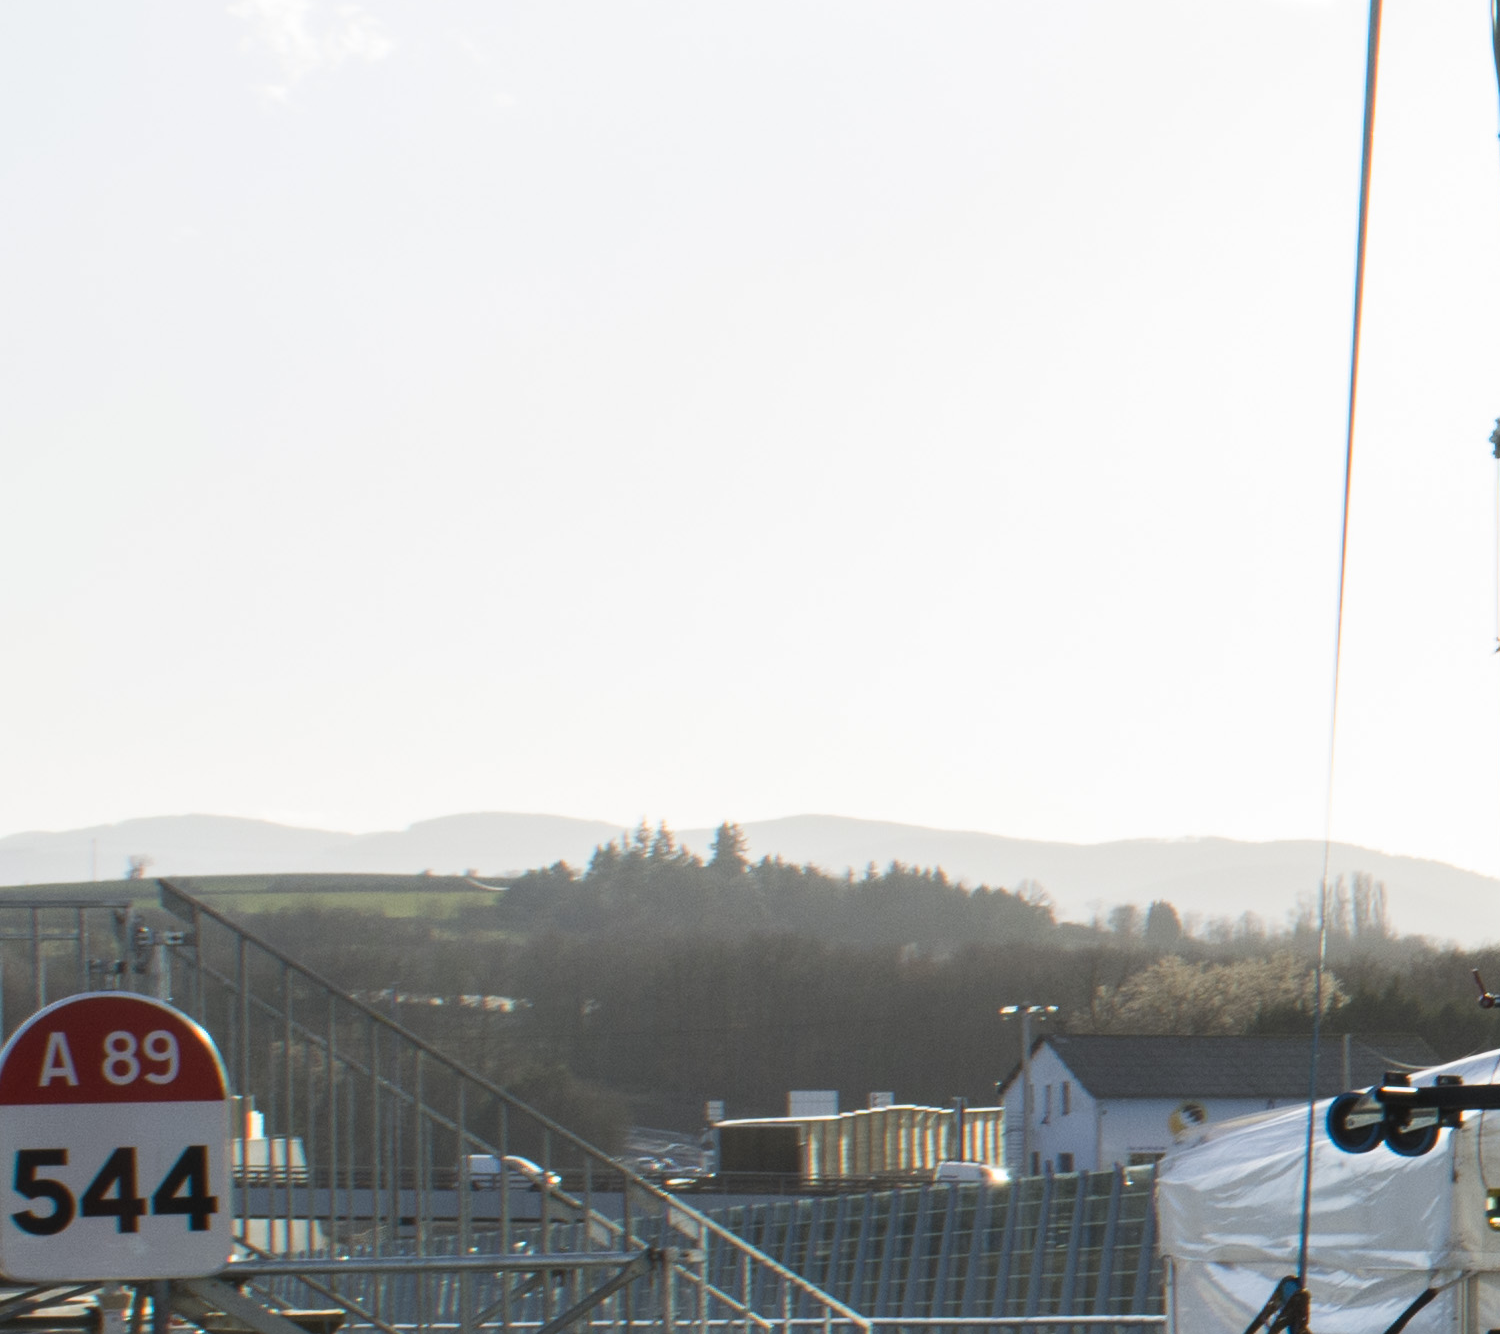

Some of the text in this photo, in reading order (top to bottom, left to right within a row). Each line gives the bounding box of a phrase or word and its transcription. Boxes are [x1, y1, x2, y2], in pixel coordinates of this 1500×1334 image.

[39, 1030, 181, 1087] A 89
[10, 1145, 219, 1236] 544
